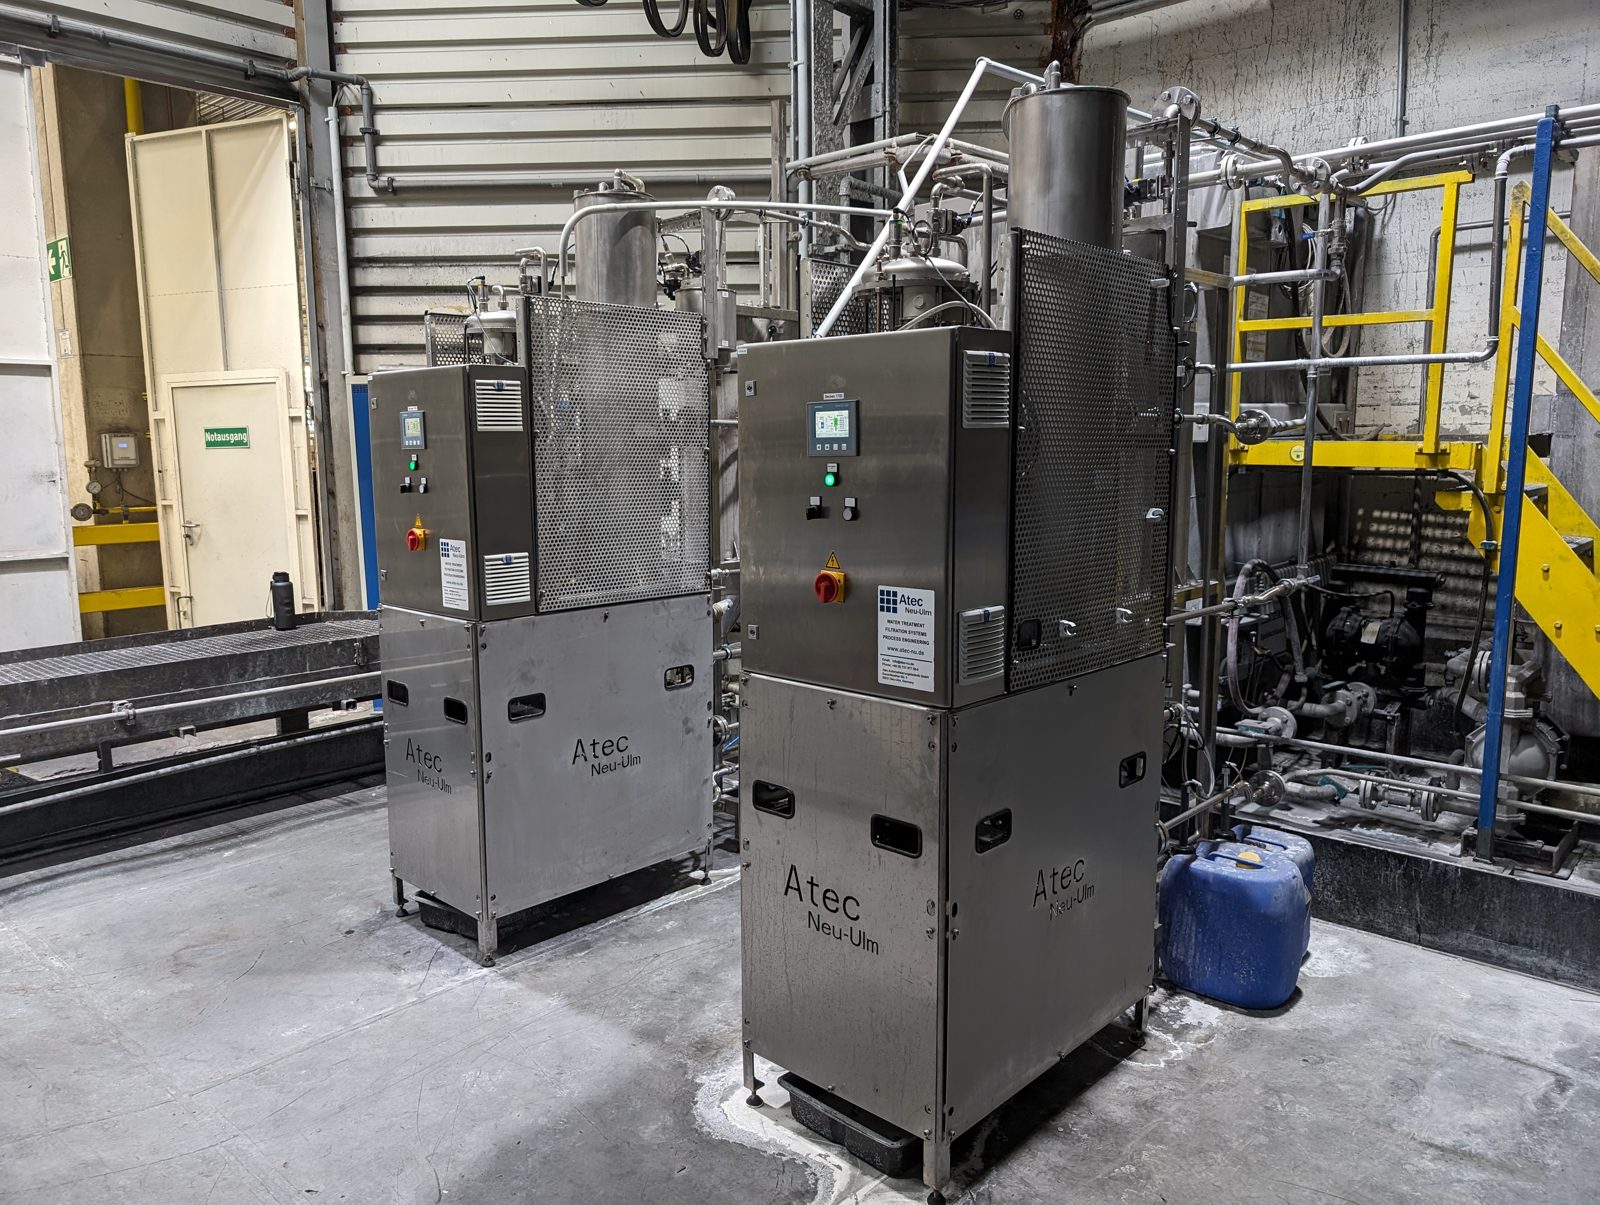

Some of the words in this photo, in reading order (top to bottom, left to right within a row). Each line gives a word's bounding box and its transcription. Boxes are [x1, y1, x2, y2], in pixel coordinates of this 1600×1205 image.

[205, 432, 247, 443] Notausgang
[899, 594, 923, 607] Atec
[905, 607, 932, 616] Neu-Ulm
[901, 620, 925, 628] TREATMENT
[908, 629, 927, 637] SYSTEMS
[887, 646, 924, 656] www.atec-nu.de
[902, 637, 929, 646] ENGINEERING
[406, 738, 442, 773] Atec
[572, 736, 628, 765] Atec
[591, 754, 641, 776] Neu-Ulm
[417, 769, 452, 795] Neu-Ulm
[784, 864, 860, 922] Atec
[1033, 859, 1085, 908] Atec
[1049, 883, 1095, 921] Neu-Ulm
[808, 910, 879, 956] Neu-Ulm
